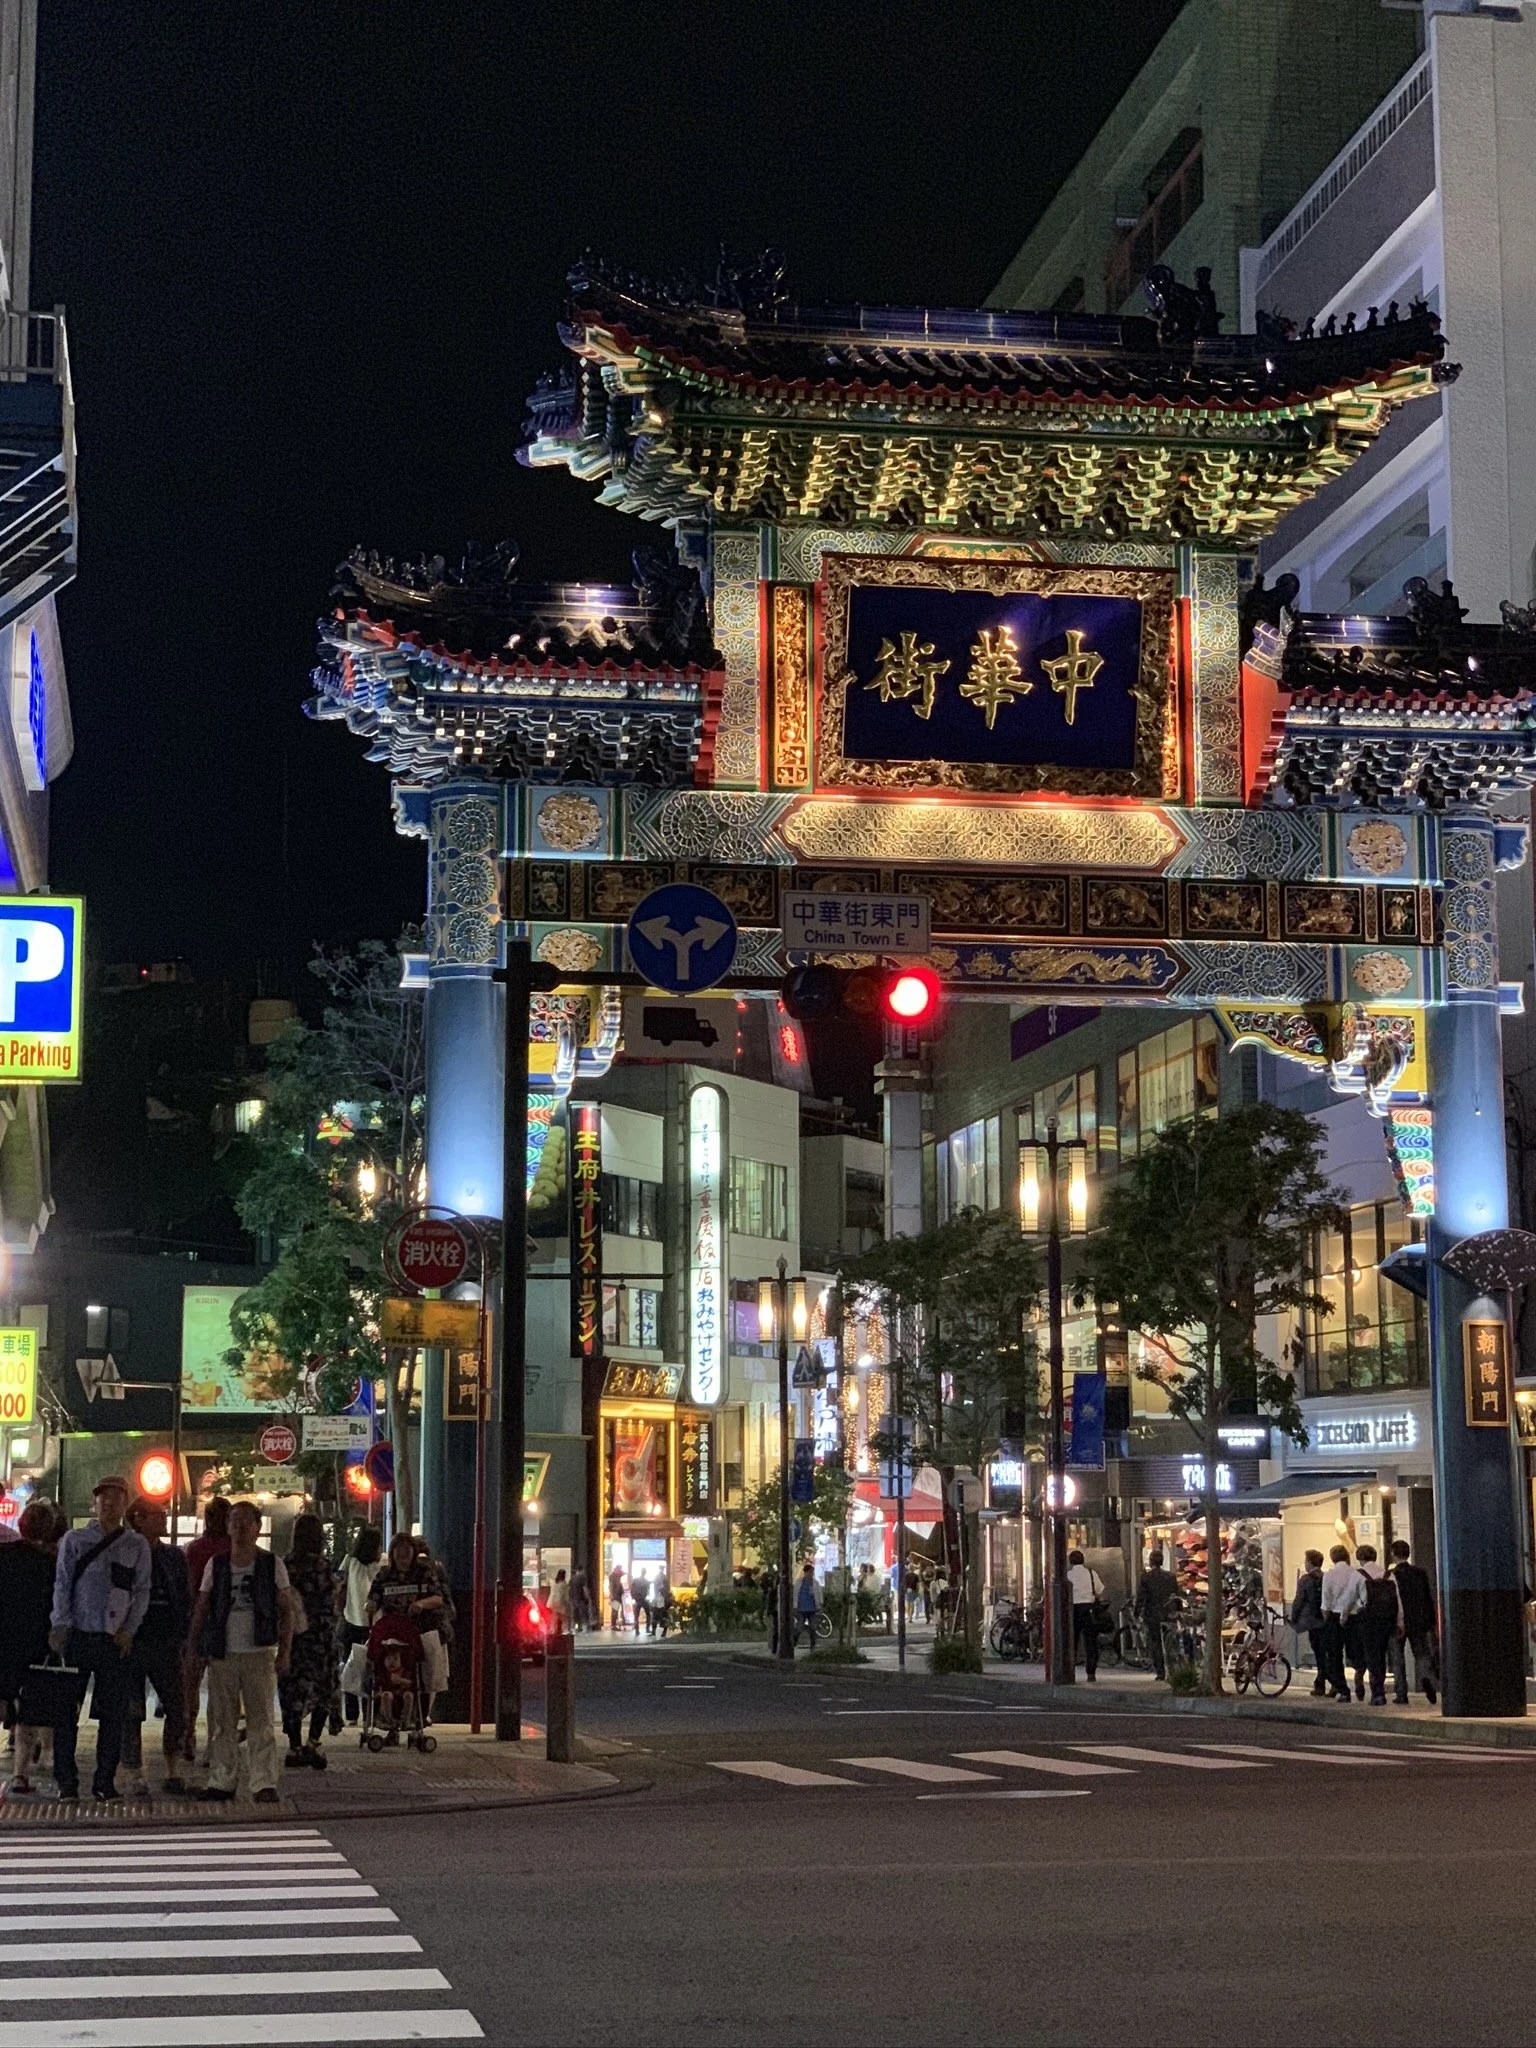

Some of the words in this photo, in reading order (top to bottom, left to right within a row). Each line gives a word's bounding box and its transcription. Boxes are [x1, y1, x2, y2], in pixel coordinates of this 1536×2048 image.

[792, 900, 920, 929] 中華街東門
[804, 929, 845, 945] China
[852, 930, 890, 946] Town
[896, 932, 910, 947] E.
[0, 919, 65, 1023] P
[10, 1039, 72, 1071] Parking
[403, 1240, 460, 1267] 消火栓
[195, 1296, 220, 1305] KIRIN
[0, 1334, 31, 1357] 車場
[0, 1361, 27, 1386] 00
[458, 1352, 480, 1407] 陽門
[1476, 1329, 1500, 1413] 朝陽門
[0, 1392, 27, 1418] 00
[264, 1437, 293, 1451] 消火栓
